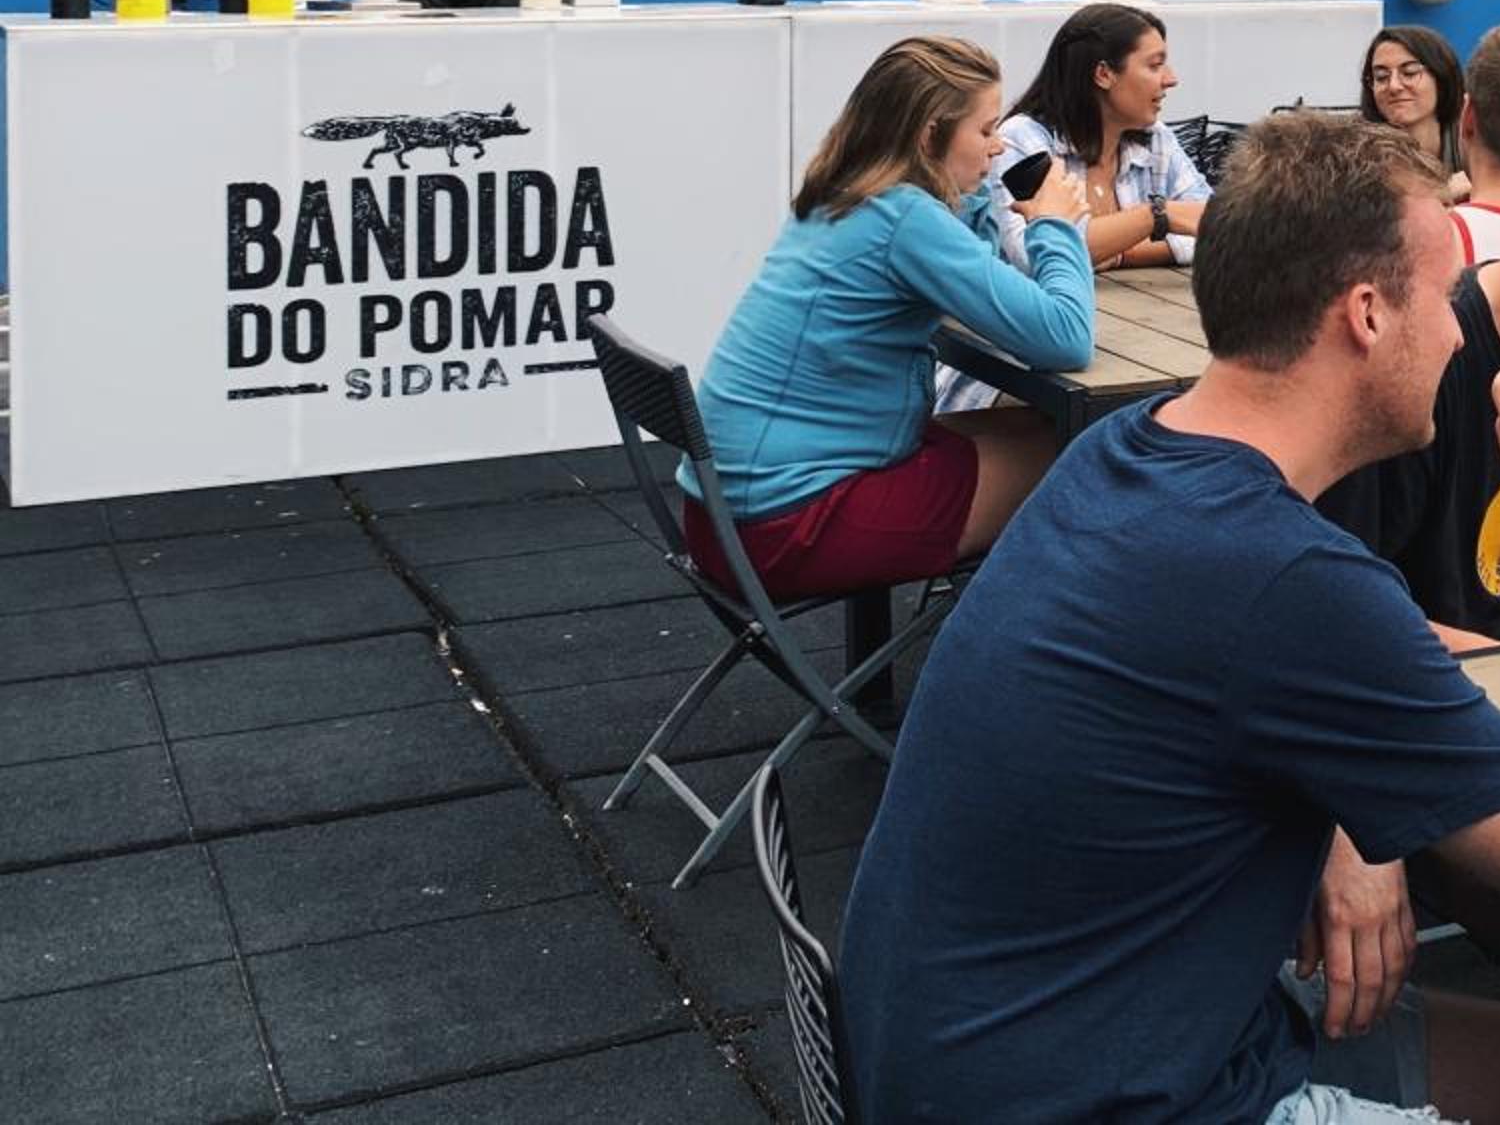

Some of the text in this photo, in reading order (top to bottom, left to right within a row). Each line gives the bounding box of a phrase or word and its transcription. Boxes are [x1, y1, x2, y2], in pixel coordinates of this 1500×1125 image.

[227, 166, 615, 291] BANDIDA
[227, 279, 615, 369] DO POMAR
[344, 357, 511, 401] SIDRA
